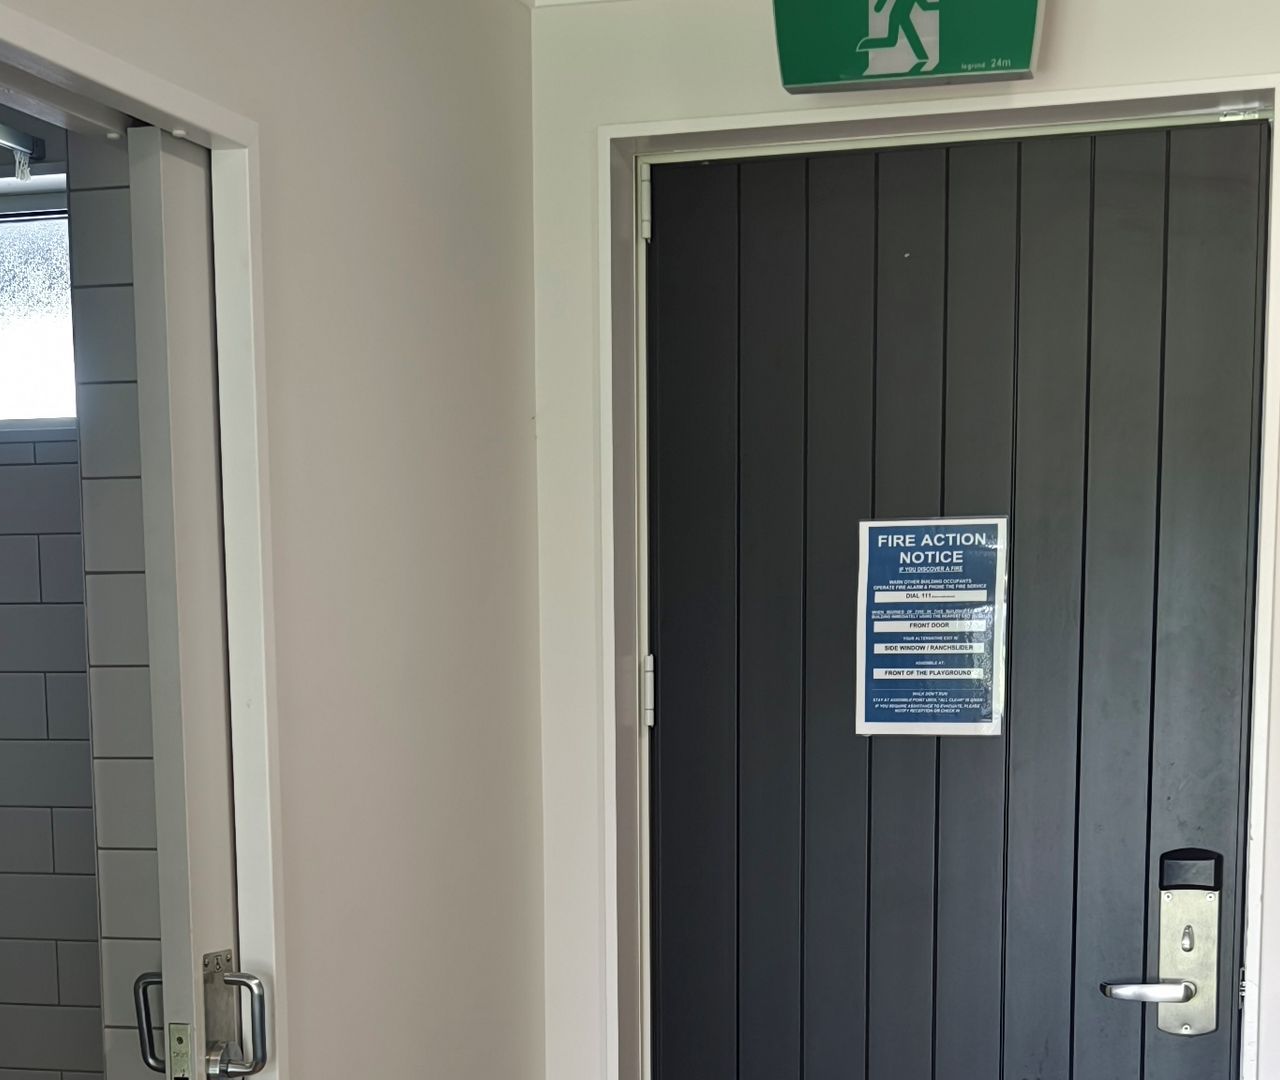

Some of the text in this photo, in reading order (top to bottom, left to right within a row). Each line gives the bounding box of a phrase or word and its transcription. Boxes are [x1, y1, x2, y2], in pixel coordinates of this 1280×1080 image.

[991, 58, 1011, 68] 24m
[878, 533, 986, 547] FIRE ACTION
[899, 550, 963, 564] NOTICE
